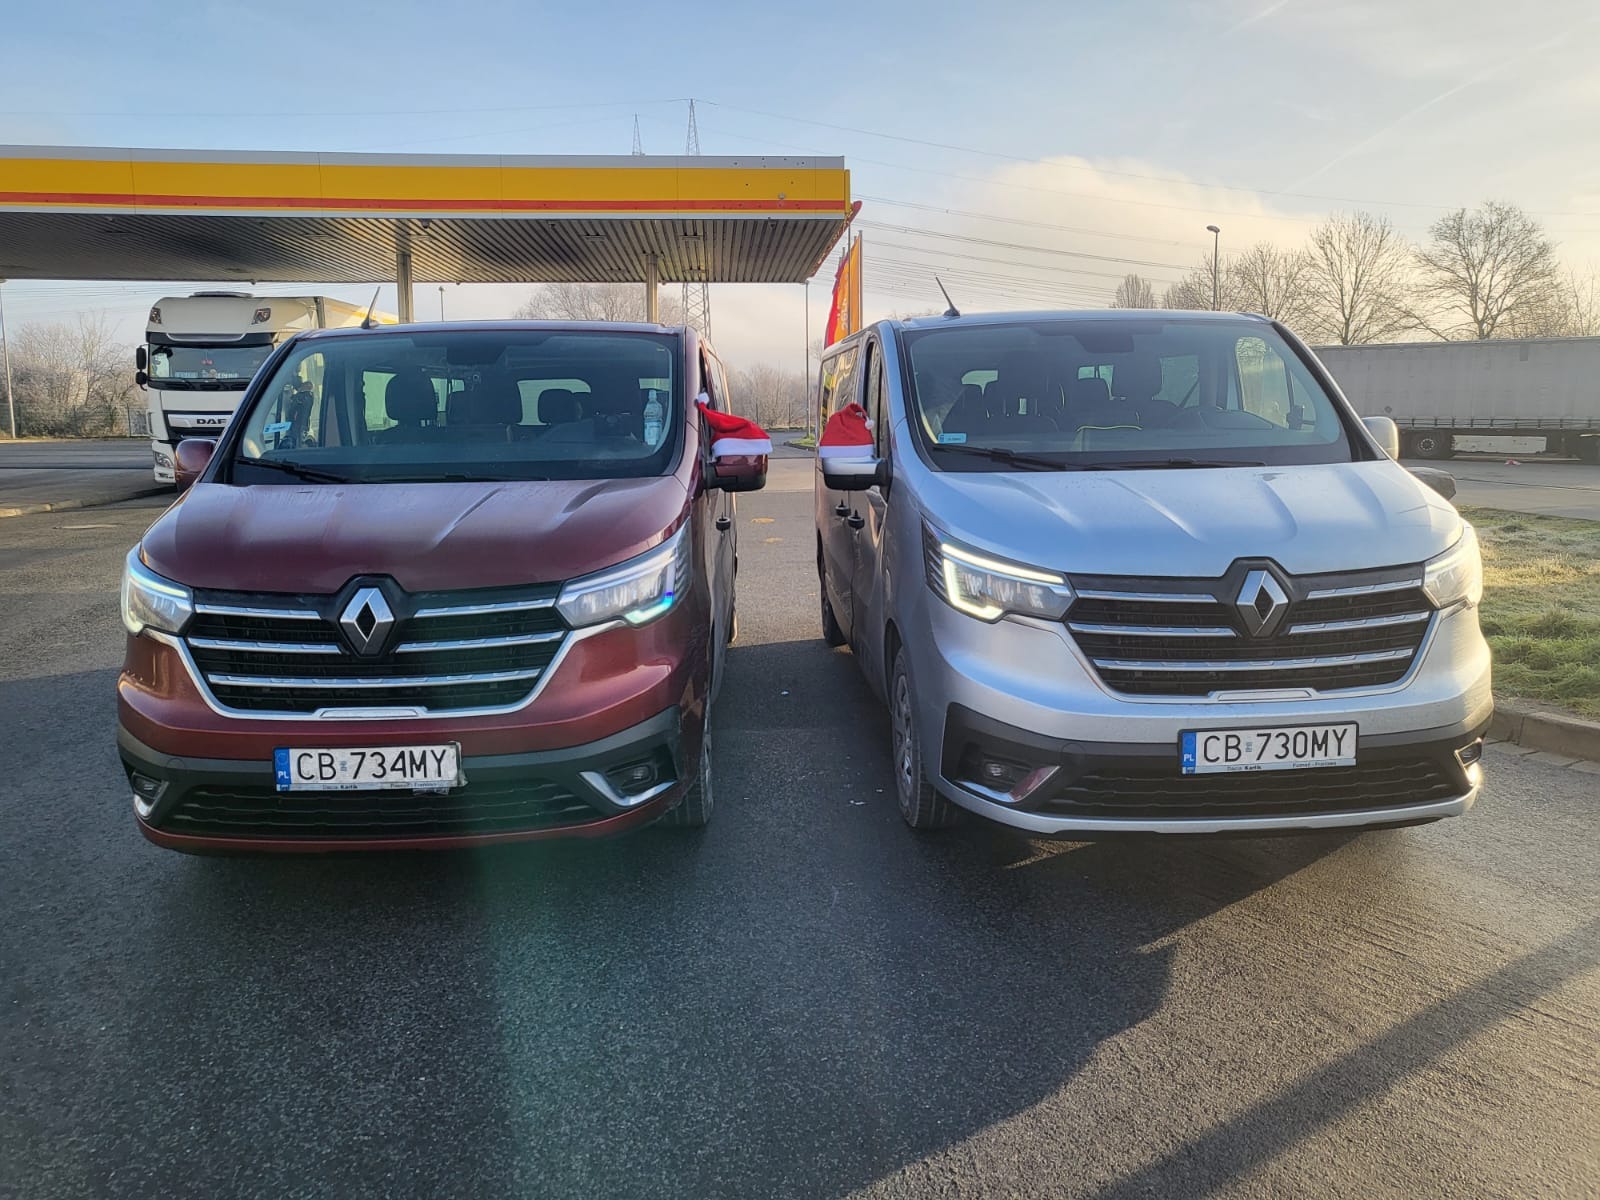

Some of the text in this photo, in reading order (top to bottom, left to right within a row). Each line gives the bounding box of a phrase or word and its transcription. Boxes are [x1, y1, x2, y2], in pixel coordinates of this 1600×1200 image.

[1203, 728, 1348, 763] CB 730MY
[297, 749, 447, 780] CB 734MY
[1184, 753, 1195, 762] PL
[278, 770, 289, 779] PL
